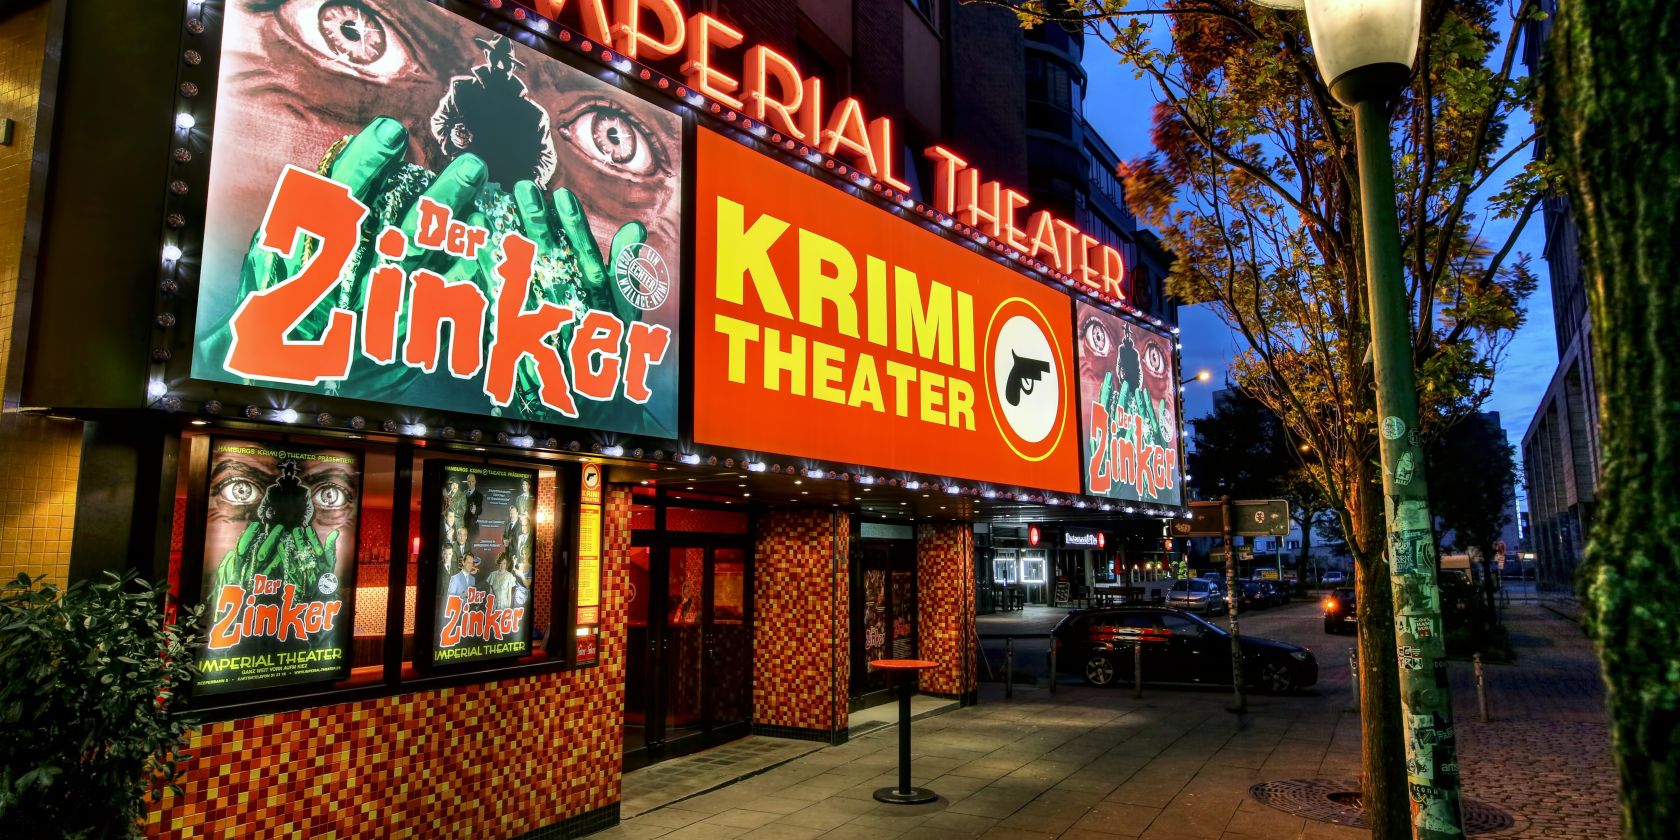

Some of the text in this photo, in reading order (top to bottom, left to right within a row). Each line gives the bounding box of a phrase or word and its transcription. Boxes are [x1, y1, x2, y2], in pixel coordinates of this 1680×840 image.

[416, 196, 486, 261] Der
[925, 146, 1126, 300] THEATER
[223, 163, 671, 418] Zinker
[630, 261, 656, 291] ECHTER
[717, 196, 975, 371] KRIMI
[715, 314, 976, 431] THEATER
[1116, 404, 1132, 430] Der
[217, 445, 255, 455] HAMBURGS
[257, 450, 278, 458] KRIMI
[286, 451, 316, 461] THEATER
[1089, 401, 1175, 499] Zinker
[252, 574, 281, 595] Der
[467, 586, 486, 603] Der
[208, 584, 342, 649] Zinker
[440, 594, 524, 647] Zinker
[199, 647, 342, 673] IMPERIAL THEATER
[434, 641, 525, 661] IMPERIAL THEATER
